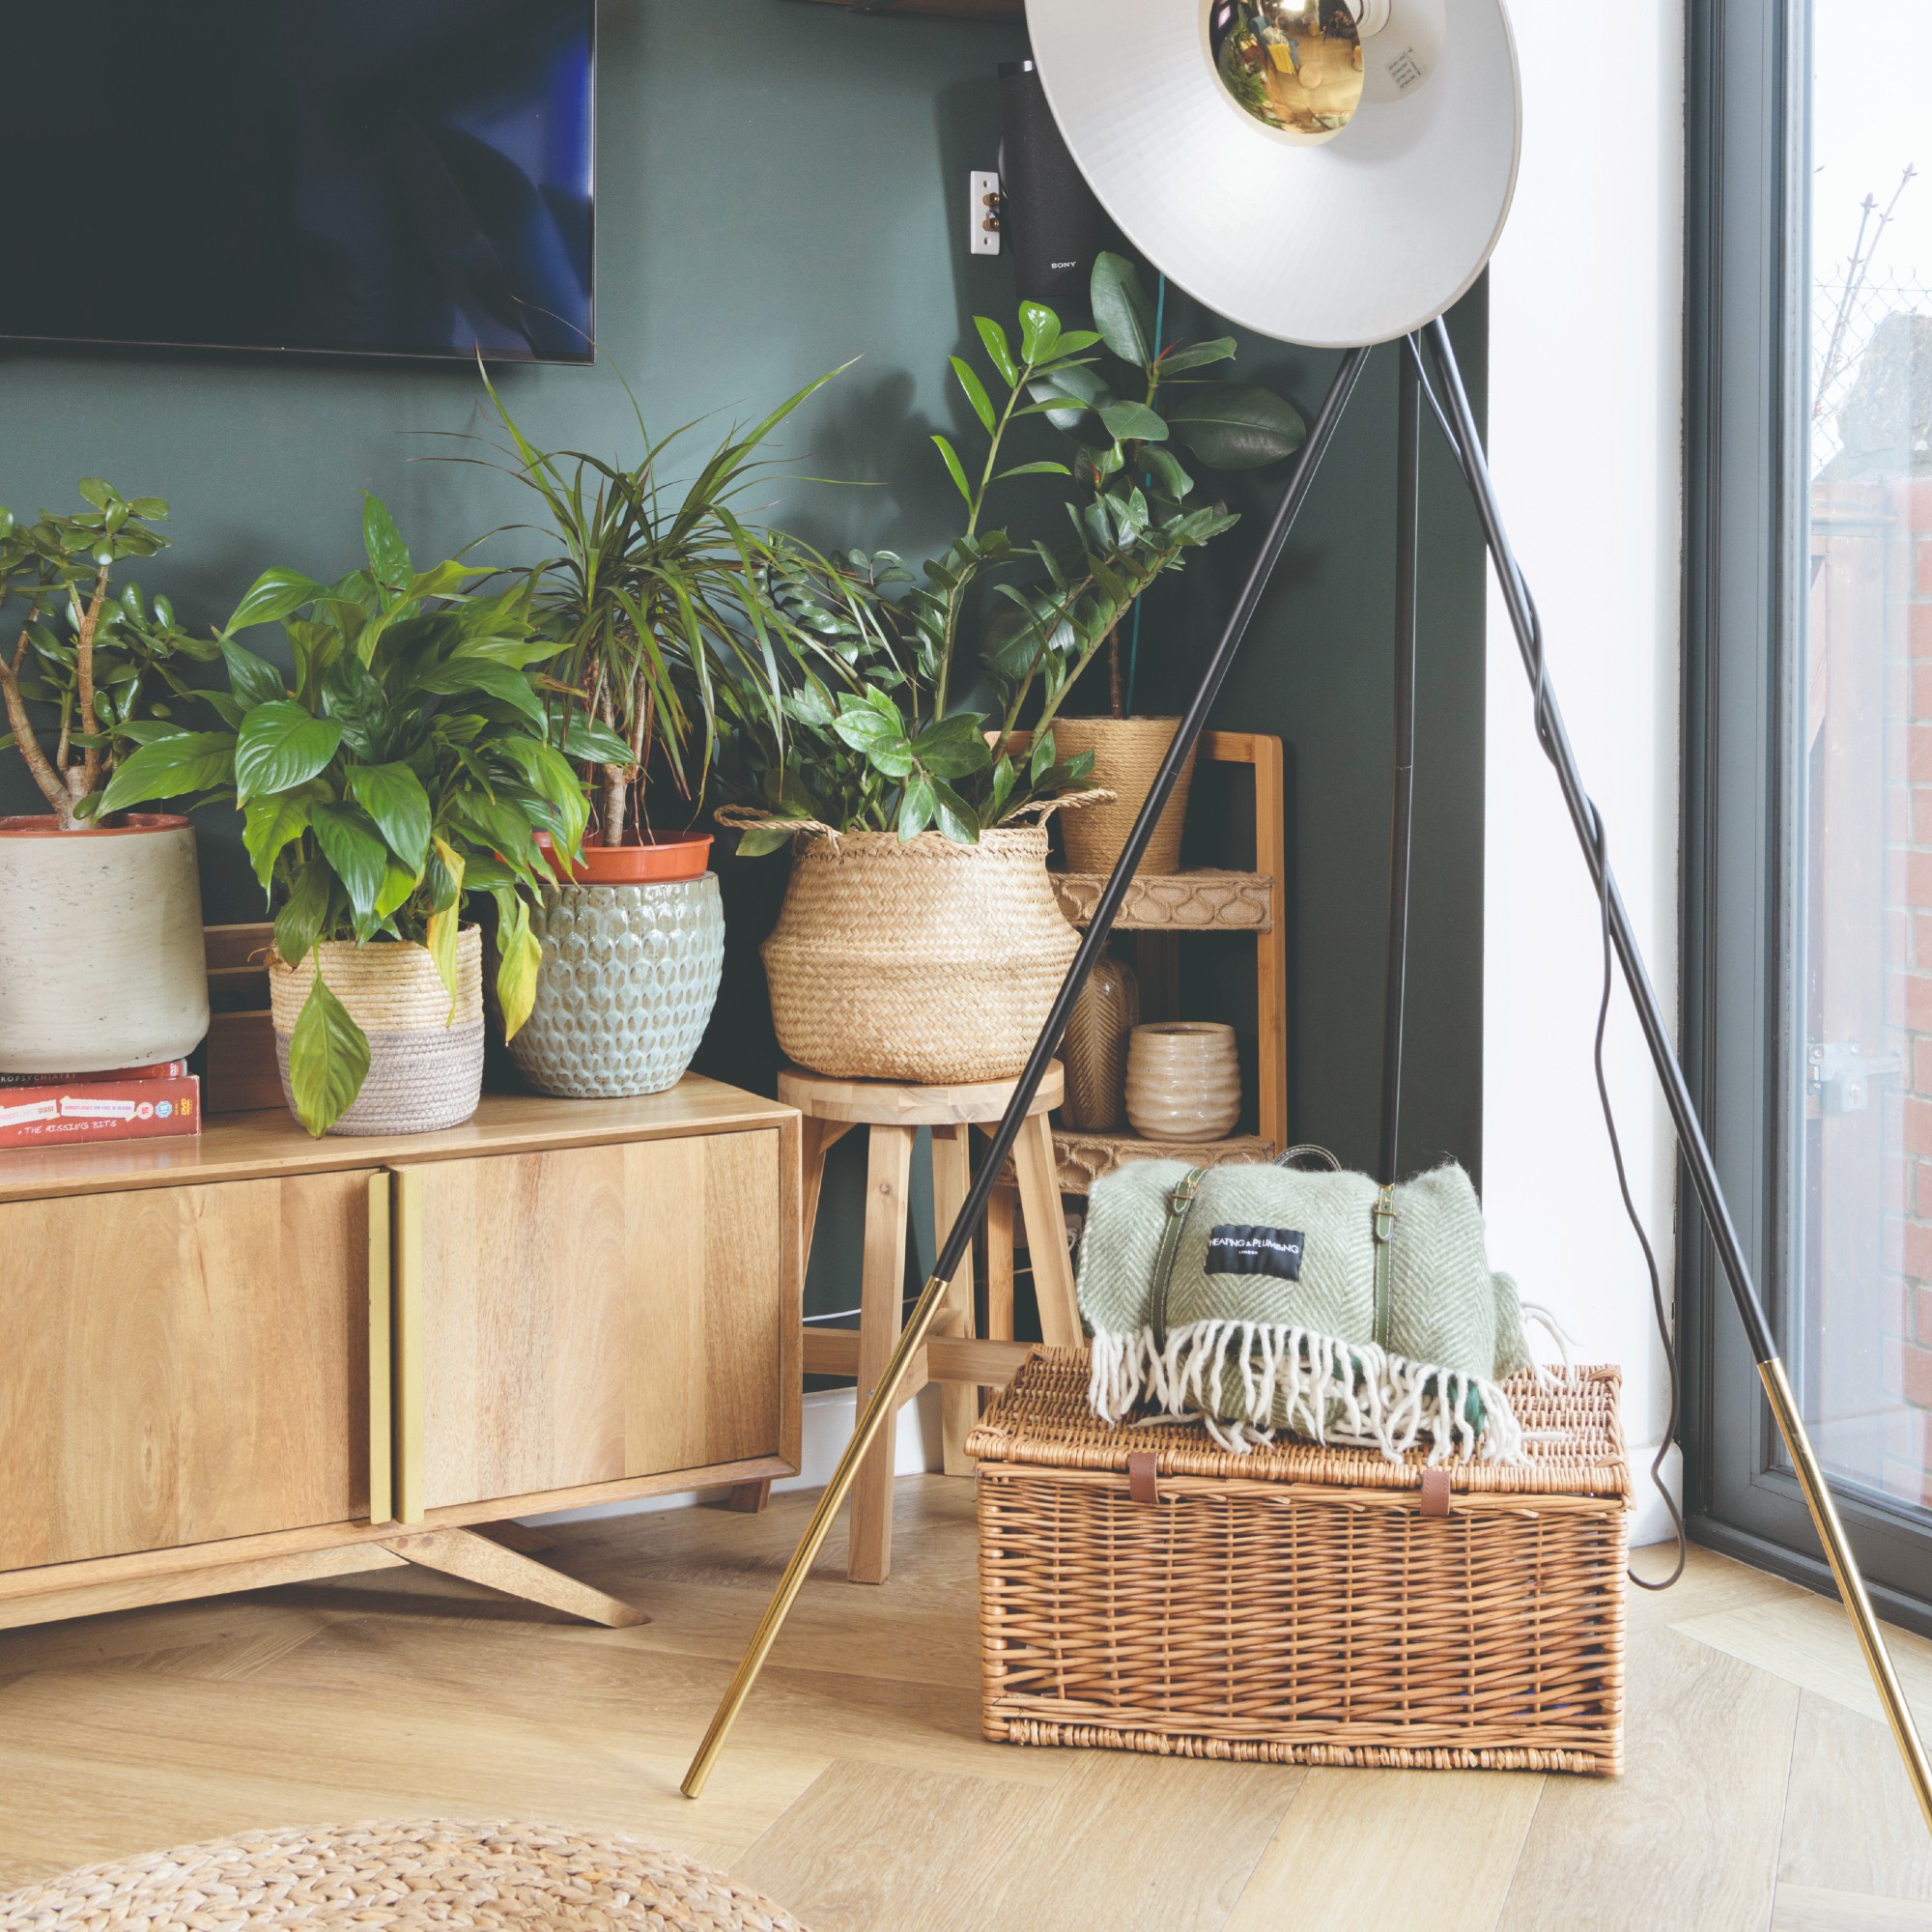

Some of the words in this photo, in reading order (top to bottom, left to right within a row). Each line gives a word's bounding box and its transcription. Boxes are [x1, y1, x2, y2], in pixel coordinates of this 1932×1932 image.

[1051, 261, 1077, 270] SONY
[159, 1104, 169, 1114] 15
[24, 1125, 43, 1134] THE
[45, 1122, 89, 1133] MISSING
[92, 1120, 117, 1129] BITS
[1208, 1237, 1246, 1248] HEATING
[1252, 1237, 1299, 1254] PLUMBING
